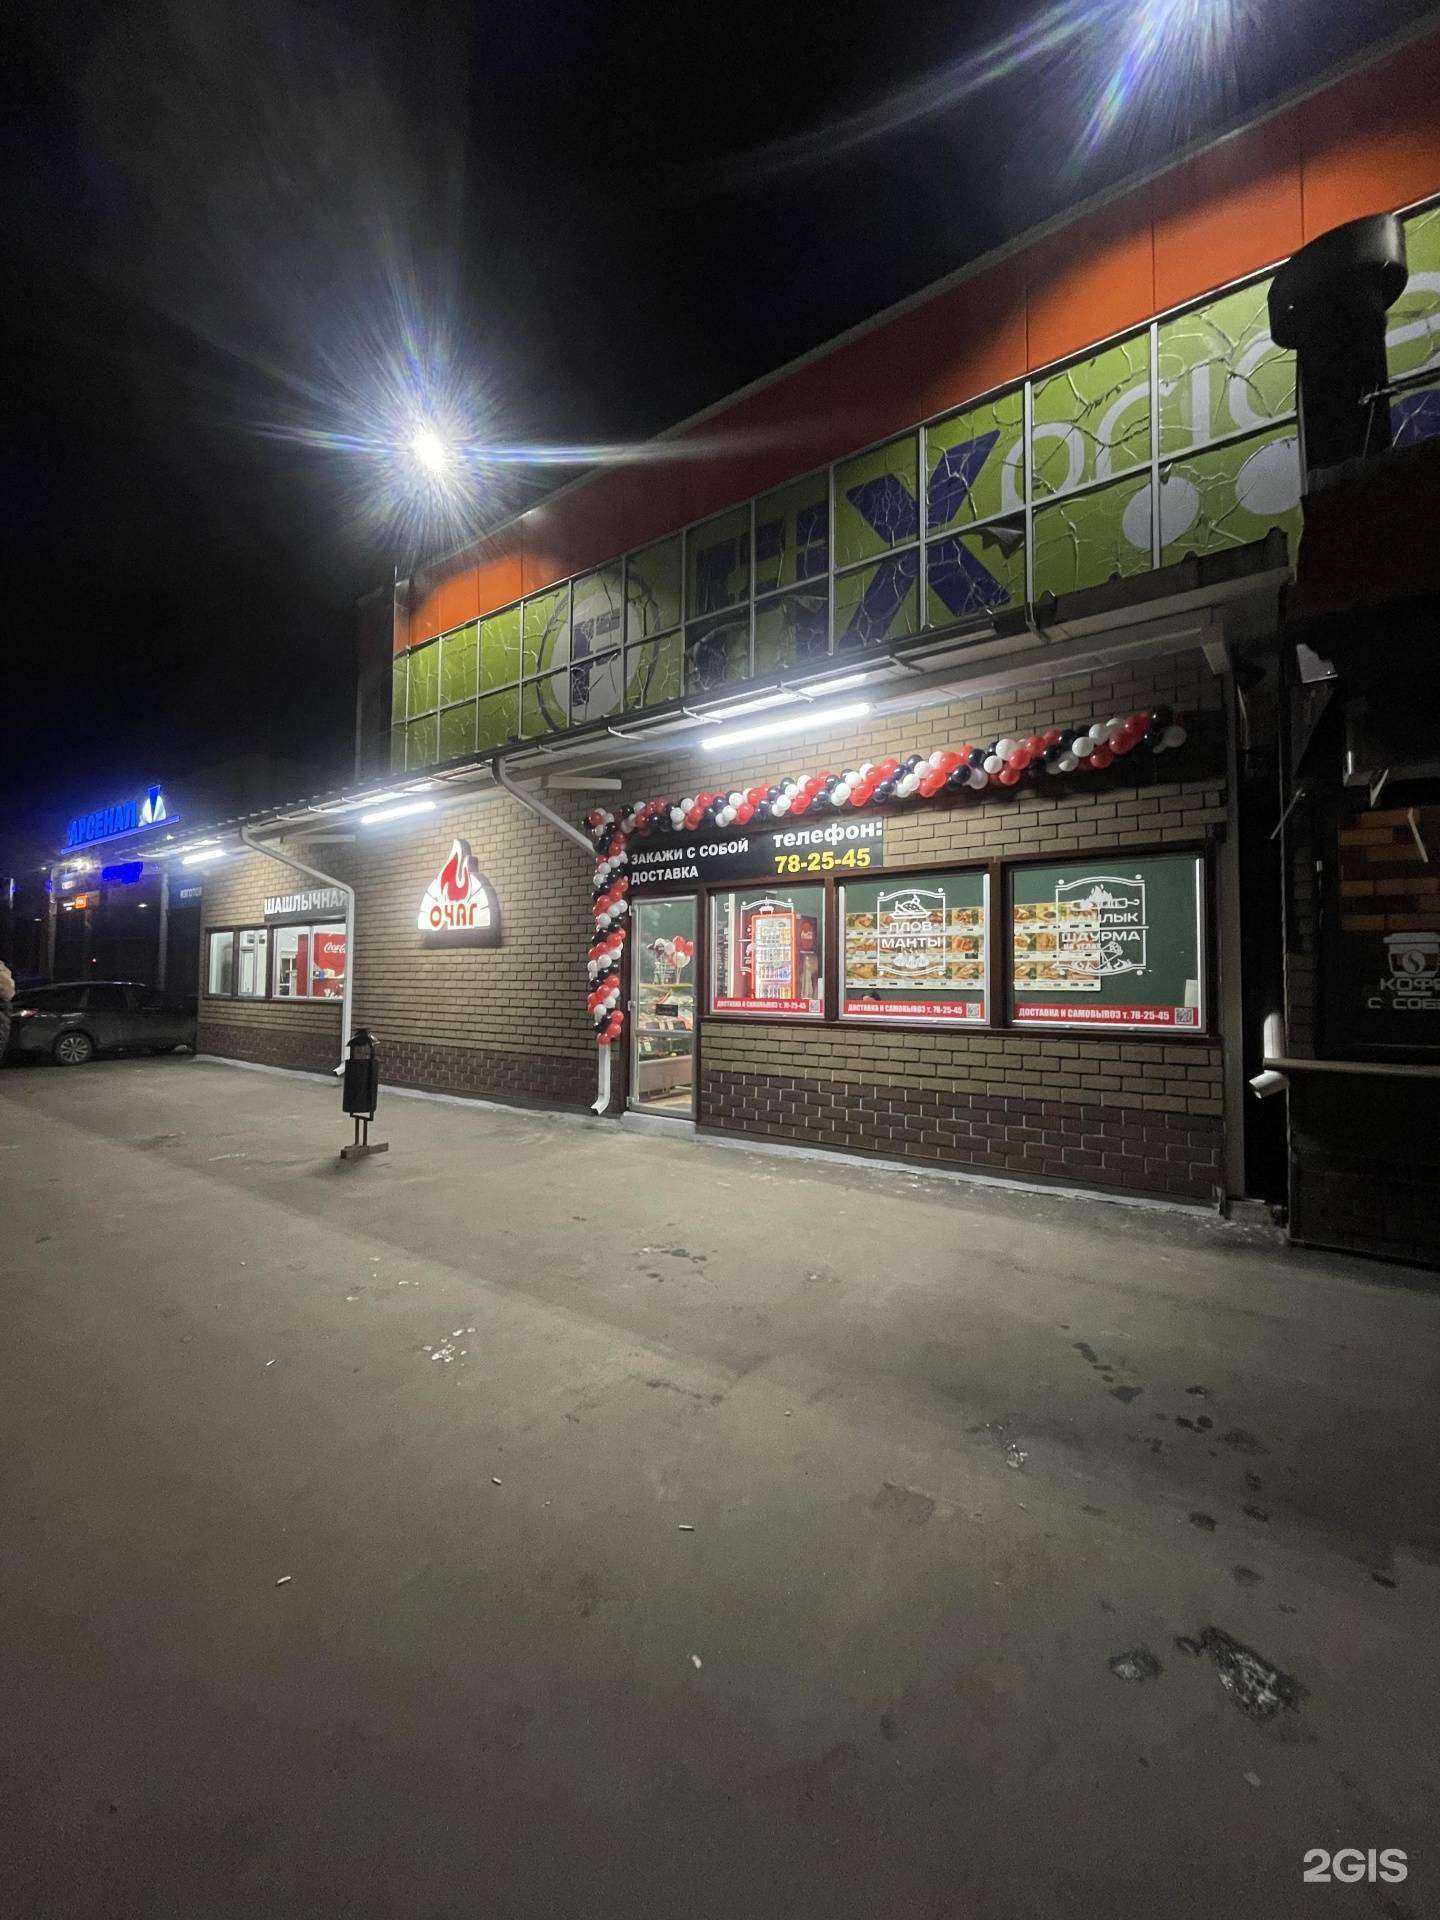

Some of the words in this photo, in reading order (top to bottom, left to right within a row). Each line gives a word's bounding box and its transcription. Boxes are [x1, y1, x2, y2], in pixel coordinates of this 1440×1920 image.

[773, 821, 883, 848] телефон:
[630, 850, 683, 866] ЗАКАЖИ
[686, 847, 696, 859] С
[699, 838, 749, 857] СОБОЙ
[775, 848, 871, 874] 78-25-45
[630, 865, 699, 885] ДОСТАВКА
[430, 903, 477, 927] ОЧАГ
[889, 921, 933, 932] ПЛОВ
[881, 937, 941, 948] МАНТЫ
[1062, 931, 1140, 941] ШАУРМА
[933, 1006, 962, 1014] 78-25-45
[1018, 1007, 1059, 1017] ДОСТАВКА
[1061, 1008, 1066, 1017] И
[1067, 1008, 1121, 1019] САМОВЫВОЗ
[1130, 1010, 1170, 1020] 78-25-45
